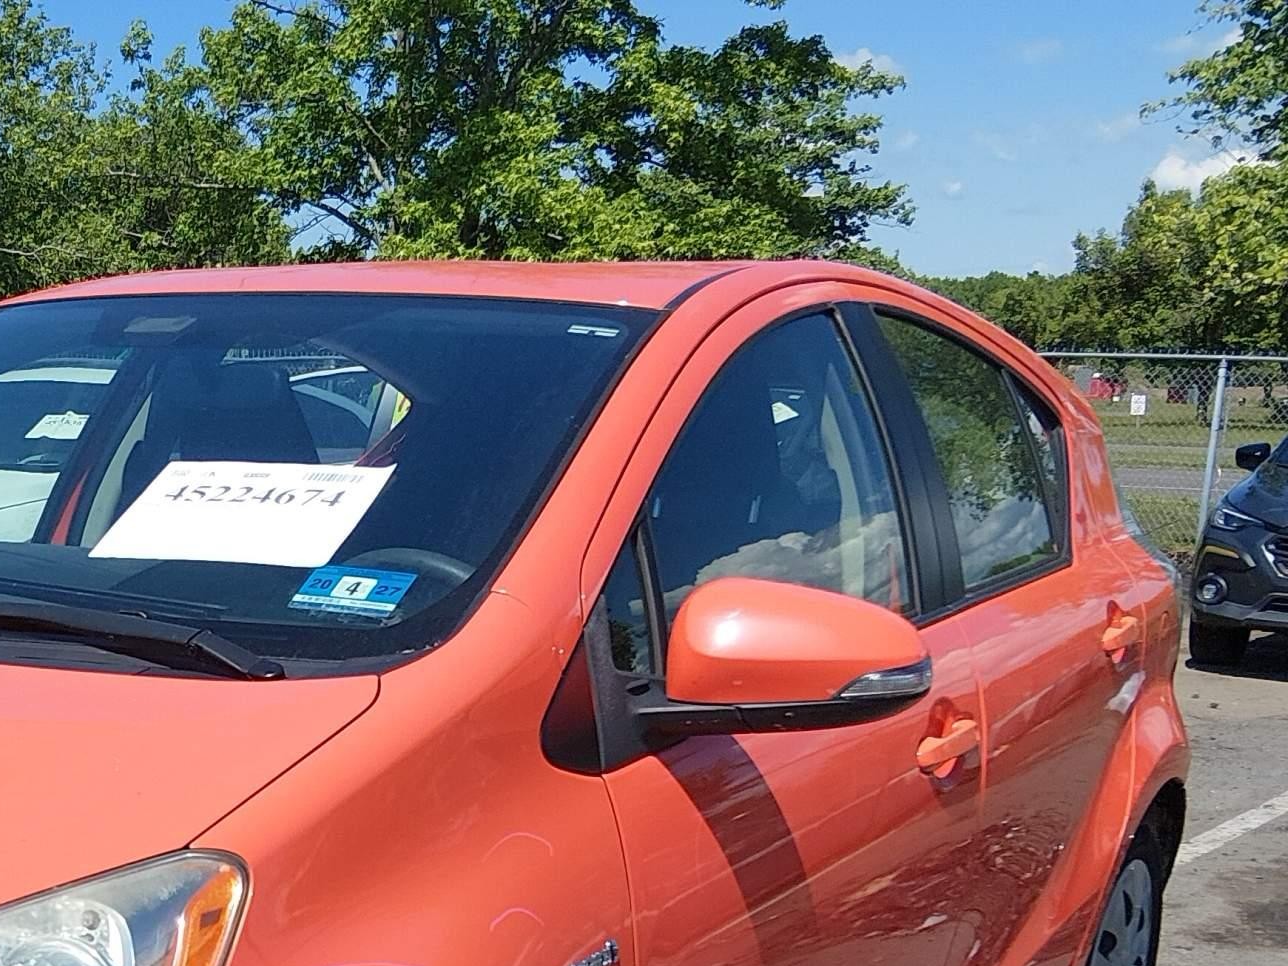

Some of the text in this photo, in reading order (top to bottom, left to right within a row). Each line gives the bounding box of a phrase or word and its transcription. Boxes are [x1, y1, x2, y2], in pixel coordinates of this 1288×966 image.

[165, 484, 346, 507] 45224674
[310, 578, 401, 597] 20 4 27
